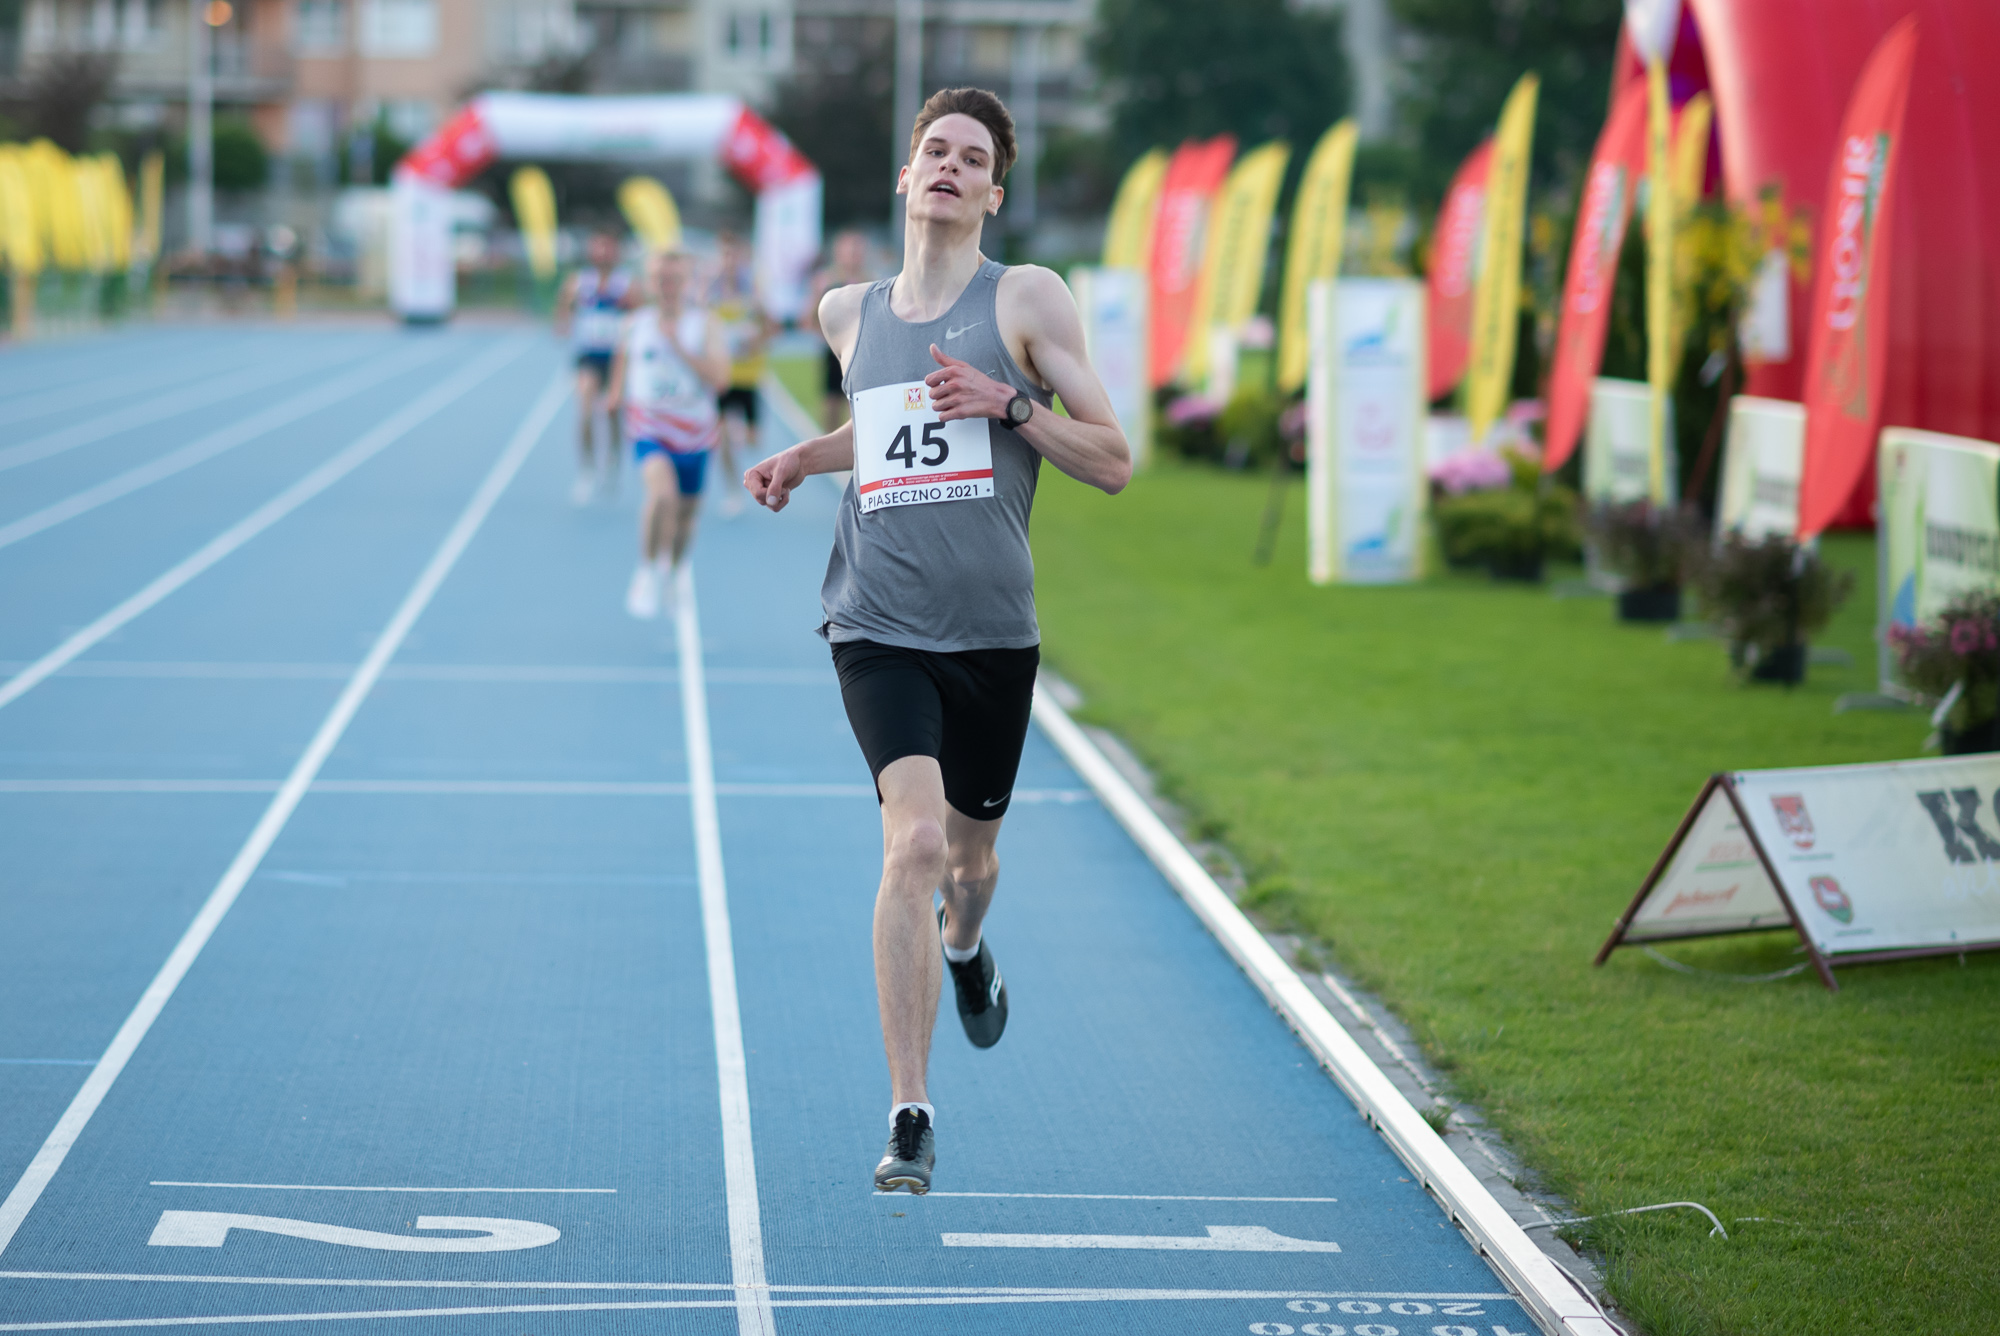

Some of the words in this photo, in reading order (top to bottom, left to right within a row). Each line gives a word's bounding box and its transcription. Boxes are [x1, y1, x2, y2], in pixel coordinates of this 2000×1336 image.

[885, 421, 949, 469] 45
[868, 487, 942, 509] PIASECZNO
[946, 484, 979, 499] 2021
[882, 478, 904, 488] PZLA
[1916, 785, 2000, 864] K
[147, 1210, 561, 1252] 2
[940, 1225, 1342, 1253] 1
[1286, 1301, 1486, 1316] 2000
